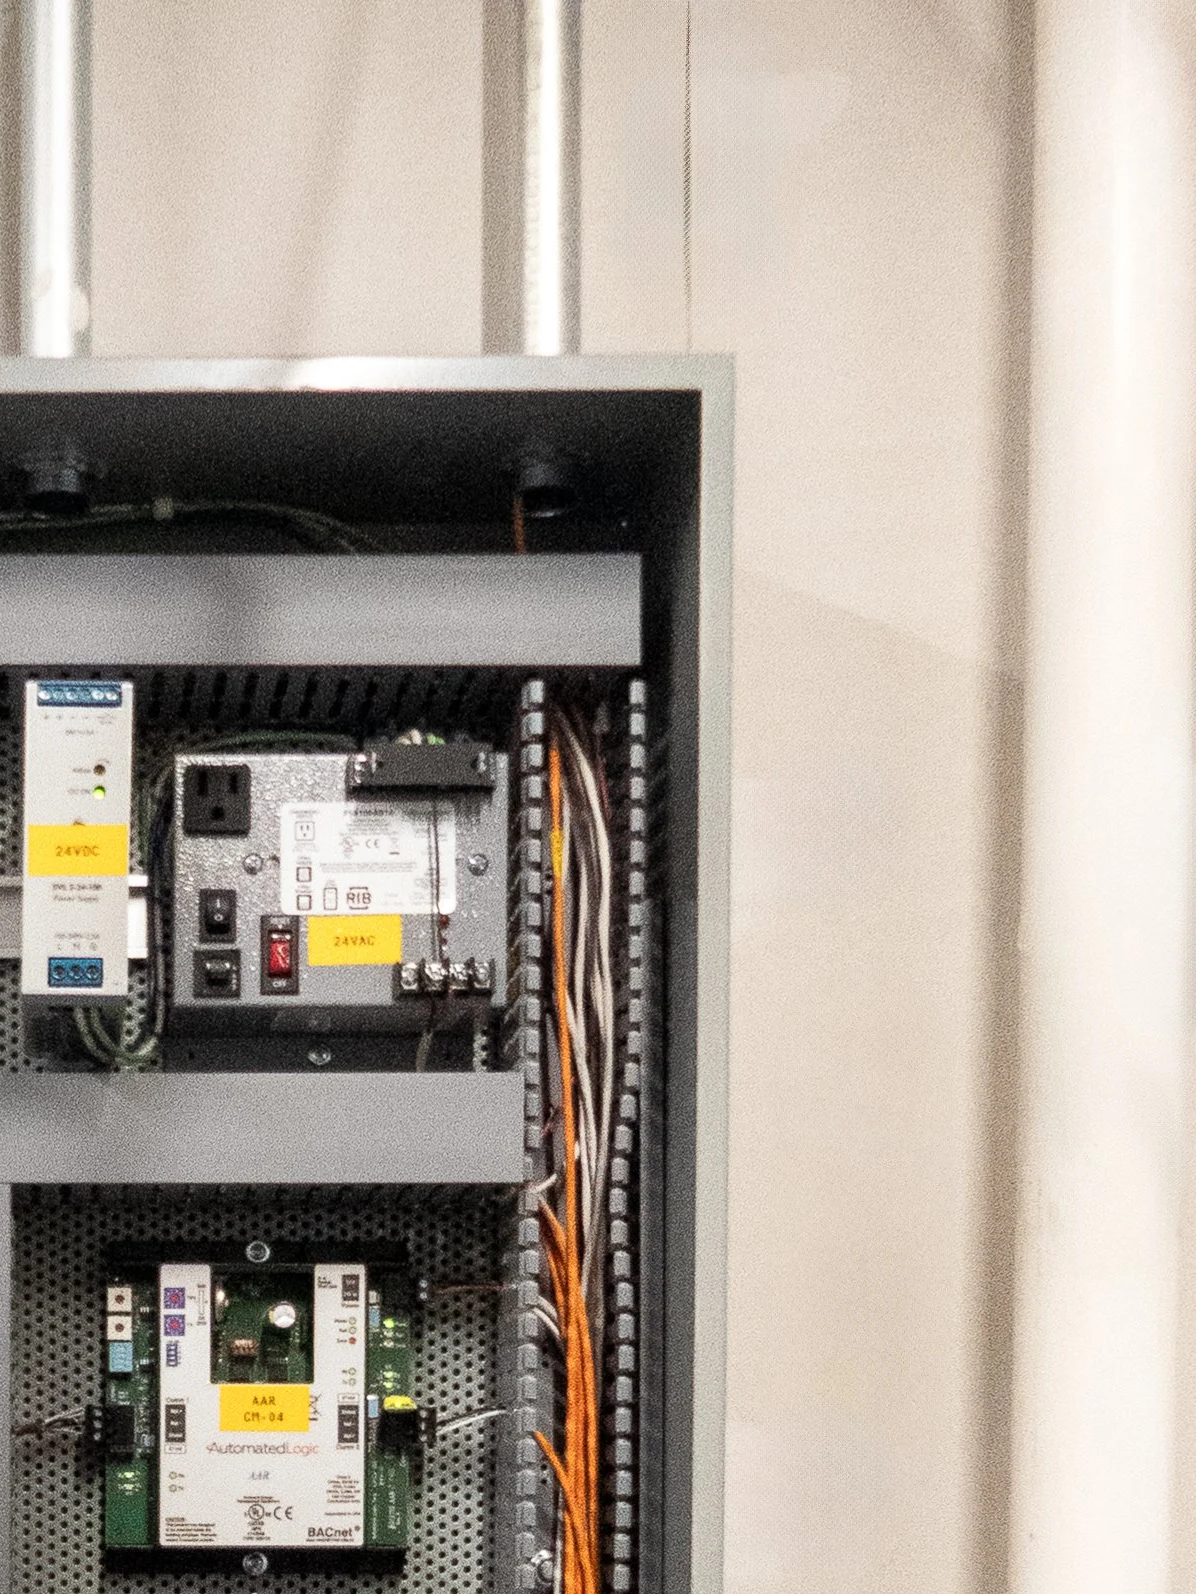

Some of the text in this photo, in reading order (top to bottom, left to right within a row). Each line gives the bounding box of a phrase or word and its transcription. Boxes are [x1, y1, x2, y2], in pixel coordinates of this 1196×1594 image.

[55, 845, 100, 858] 24VDC
[333, 935, 376, 948] 24VAC
[252, 1395, 277, 1407] AAR
[242, 1412, 285, 1423] CM-04
